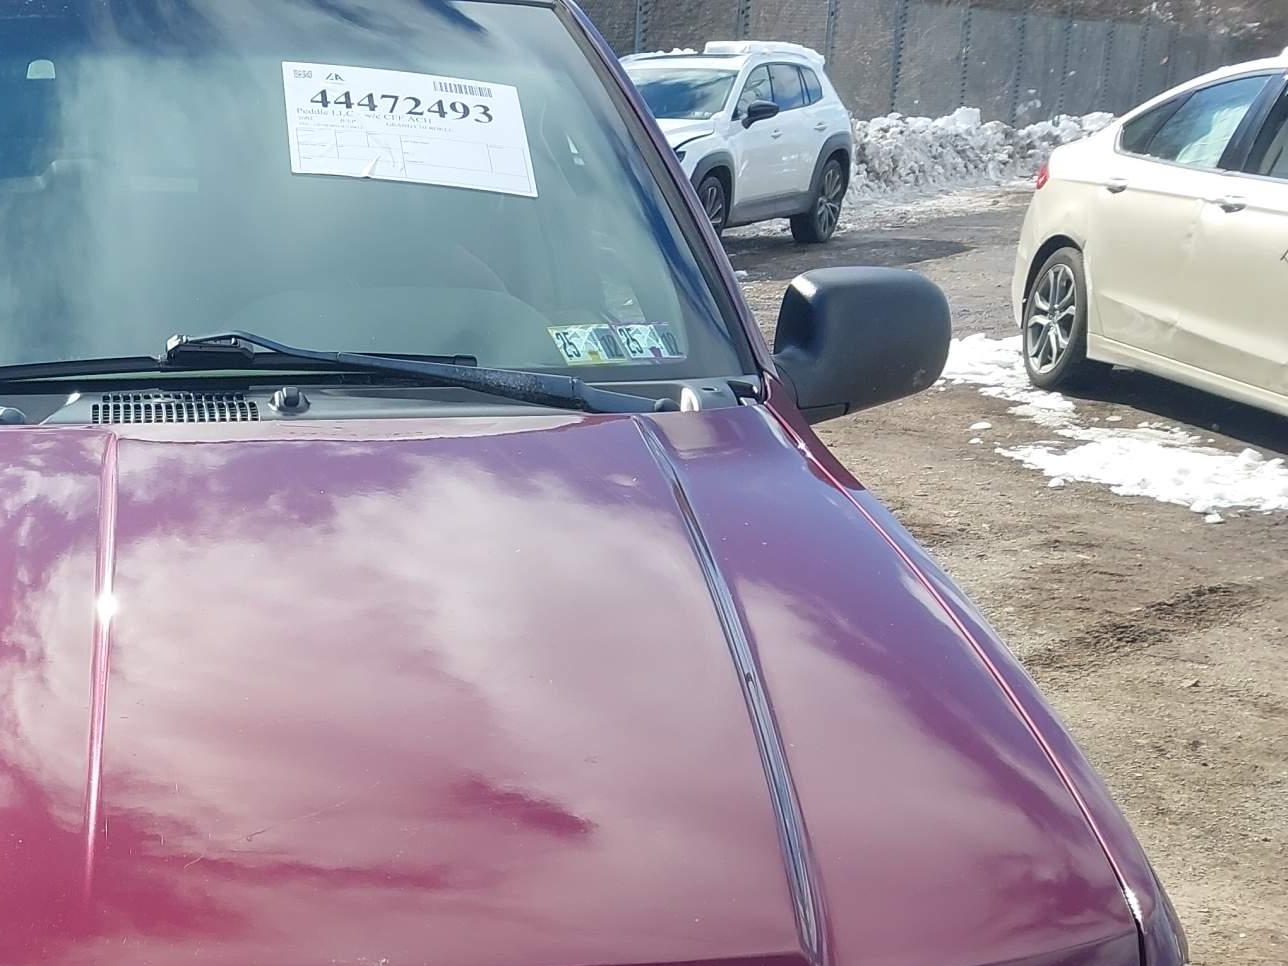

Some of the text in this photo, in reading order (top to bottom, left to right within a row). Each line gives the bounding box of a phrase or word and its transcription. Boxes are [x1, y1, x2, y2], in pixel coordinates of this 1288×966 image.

[310, 88, 494, 124] 44472493
[556, 332, 581, 359] 25
[619, 327, 644, 355] 25
